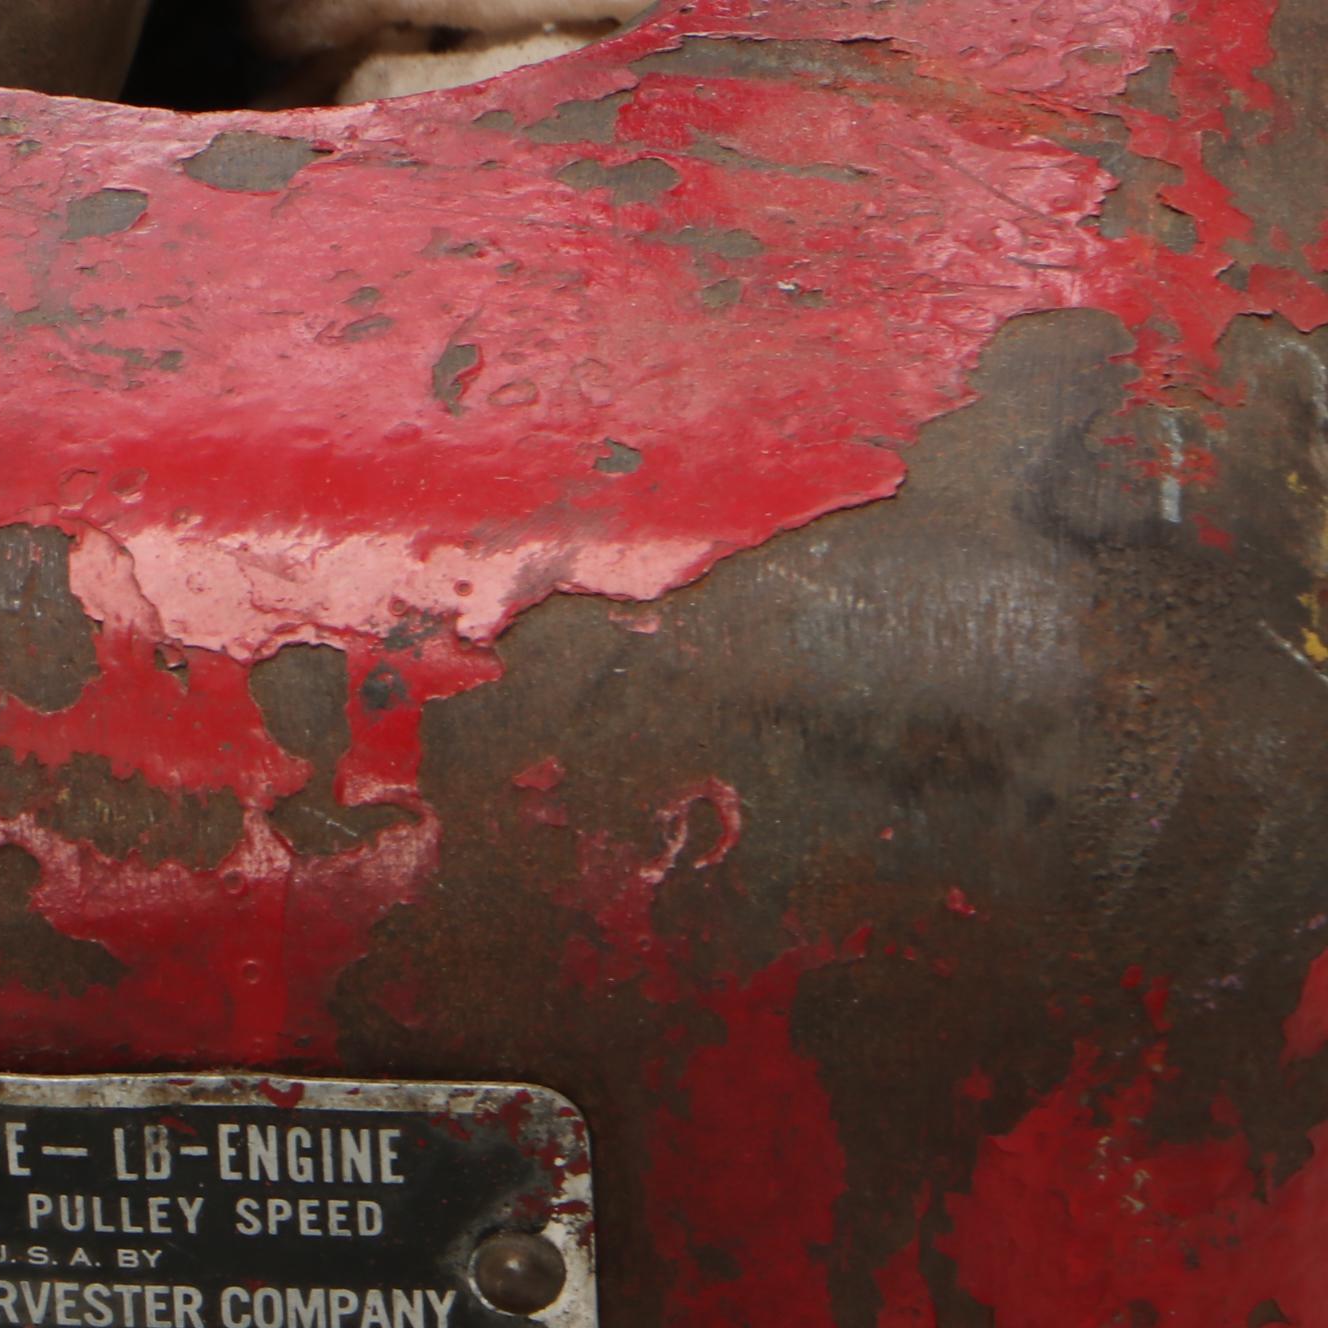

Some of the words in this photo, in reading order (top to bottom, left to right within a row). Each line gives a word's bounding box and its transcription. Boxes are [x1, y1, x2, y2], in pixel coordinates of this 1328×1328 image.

[28, 1193, 204, 1235] PULLEY
[235, 1199, 383, 1237] SPEED
[117, 1249, 163, 1269] BY
